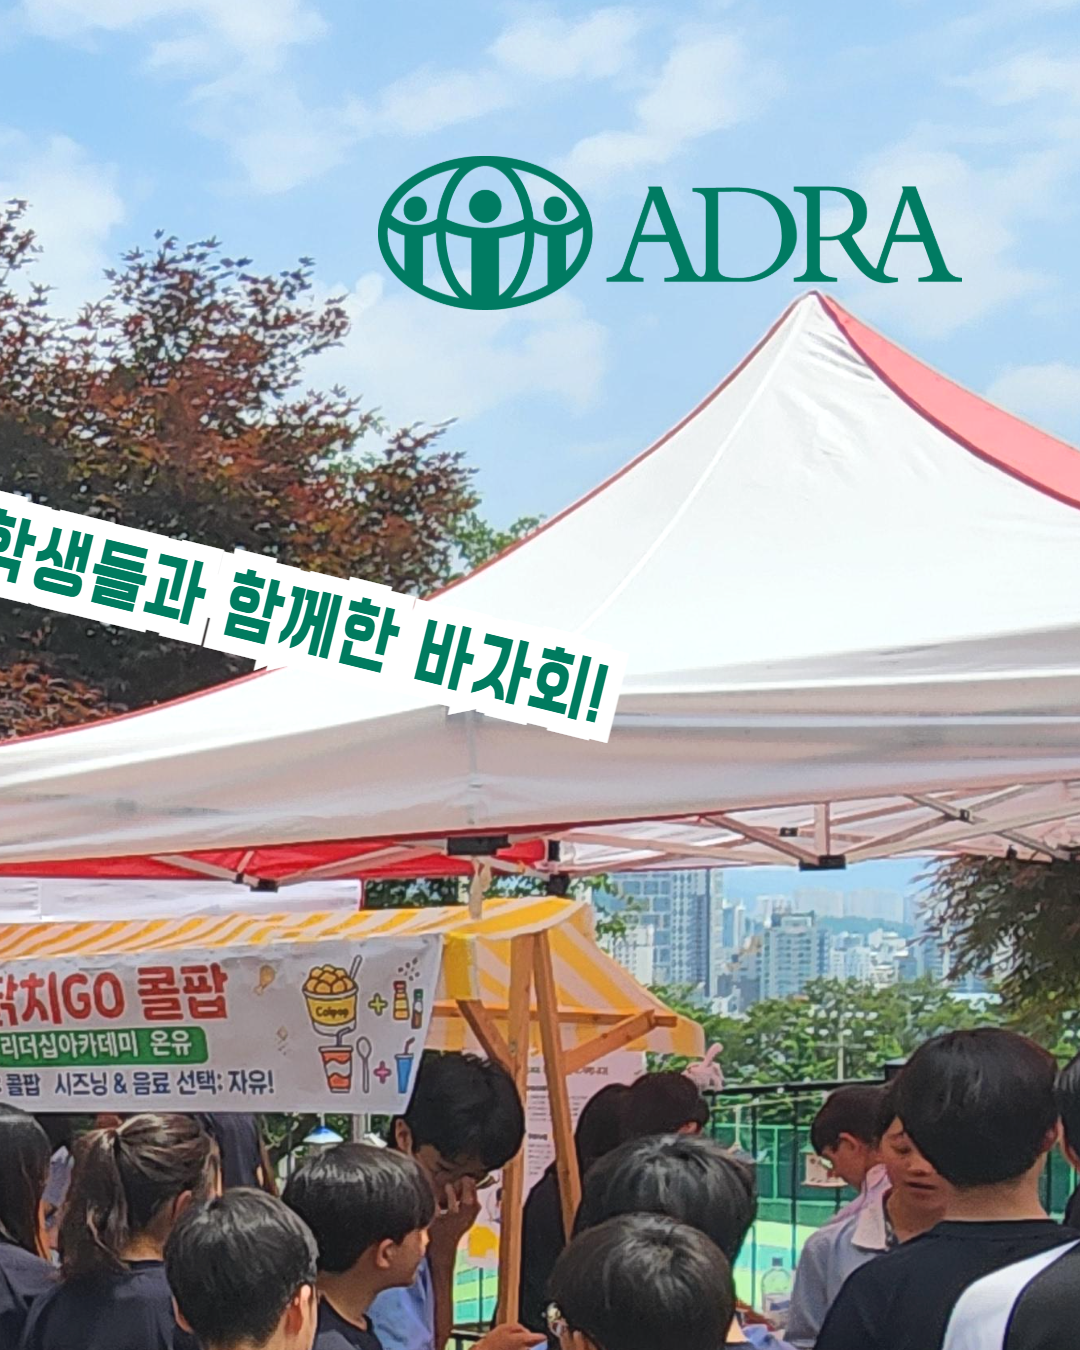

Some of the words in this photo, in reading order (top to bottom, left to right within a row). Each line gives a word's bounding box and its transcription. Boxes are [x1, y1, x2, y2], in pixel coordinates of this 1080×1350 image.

[137, 962, 228, 1021] 콜팝
[0, 1030, 139, 1060] 리더십아카데미
[150, 1029, 192, 1057] 온유
[6, 1072, 41, 1096] 콜팝
[55, 1071, 108, 1097] 시즈닝
[113, 1072, 128, 1095] &
[132, 1071, 170, 1096] 음료
[177, 1069, 224, 1096] 선택:
[228, 1069, 274, 1095] 자유!
